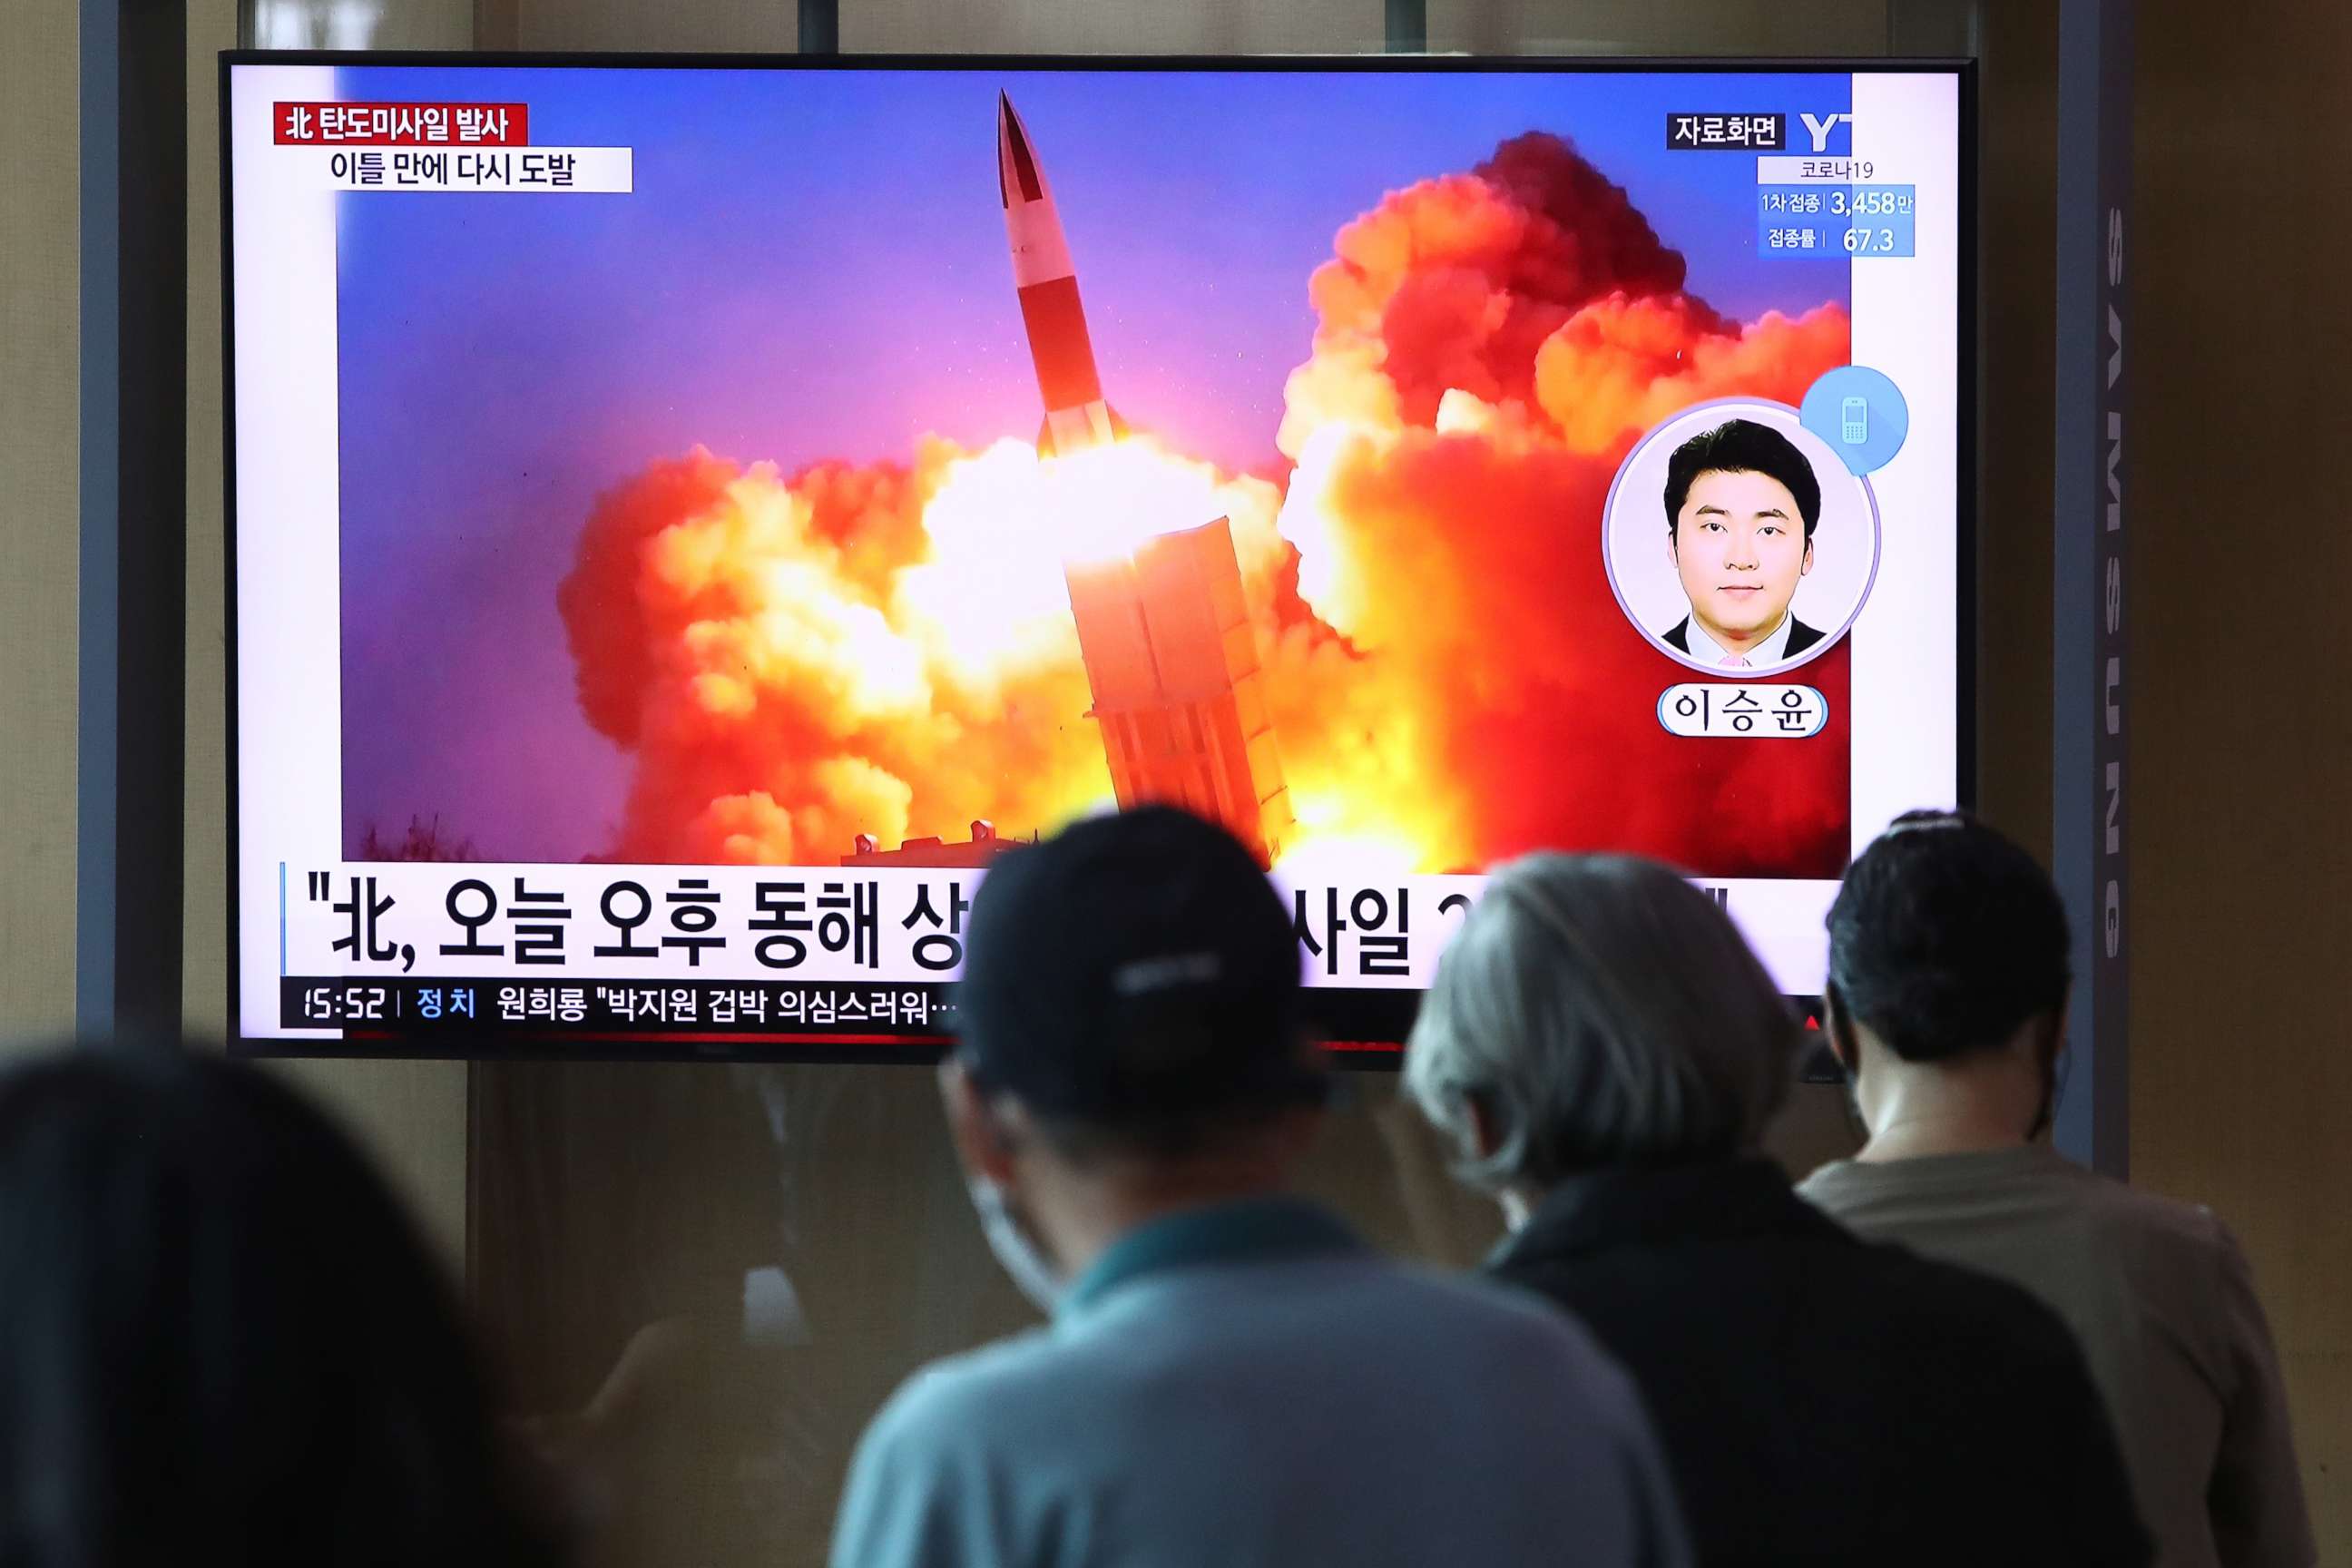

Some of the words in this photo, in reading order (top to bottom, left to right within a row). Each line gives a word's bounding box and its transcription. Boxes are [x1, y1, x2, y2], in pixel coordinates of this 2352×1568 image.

[286, 107, 314, 140] 北
[319, 108, 450, 142] 탄도미사일
[456, 108, 509, 142] 발사
[1675, 116, 1777, 146] 자료화면
[330, 152, 387, 184] 이틀
[394, 152, 449, 186] 만에
[457, 153, 512, 186] 다시
[519, 153, 576, 187] 도발
[1801, 162, 1874, 180] 코로나19
[1769, 228, 1817, 249] 접종률
[1843, 228, 1895, 252] 67.3
[2105, 207, 2123, 959] SAMSUNG
[1675, 688, 1813, 732] 이승윤
[438, 877, 573, 965] 오늘
[593, 878, 727, 967] 오후
[748, 880, 879, 970] 동해
[304, 987, 387, 1019] 15:52
[416, 987, 475, 1019] 정치
[496, 986, 588, 1023] 원희룡
[596, 986, 699, 1024] "박지원
[708, 988, 769, 1024] 겁박
